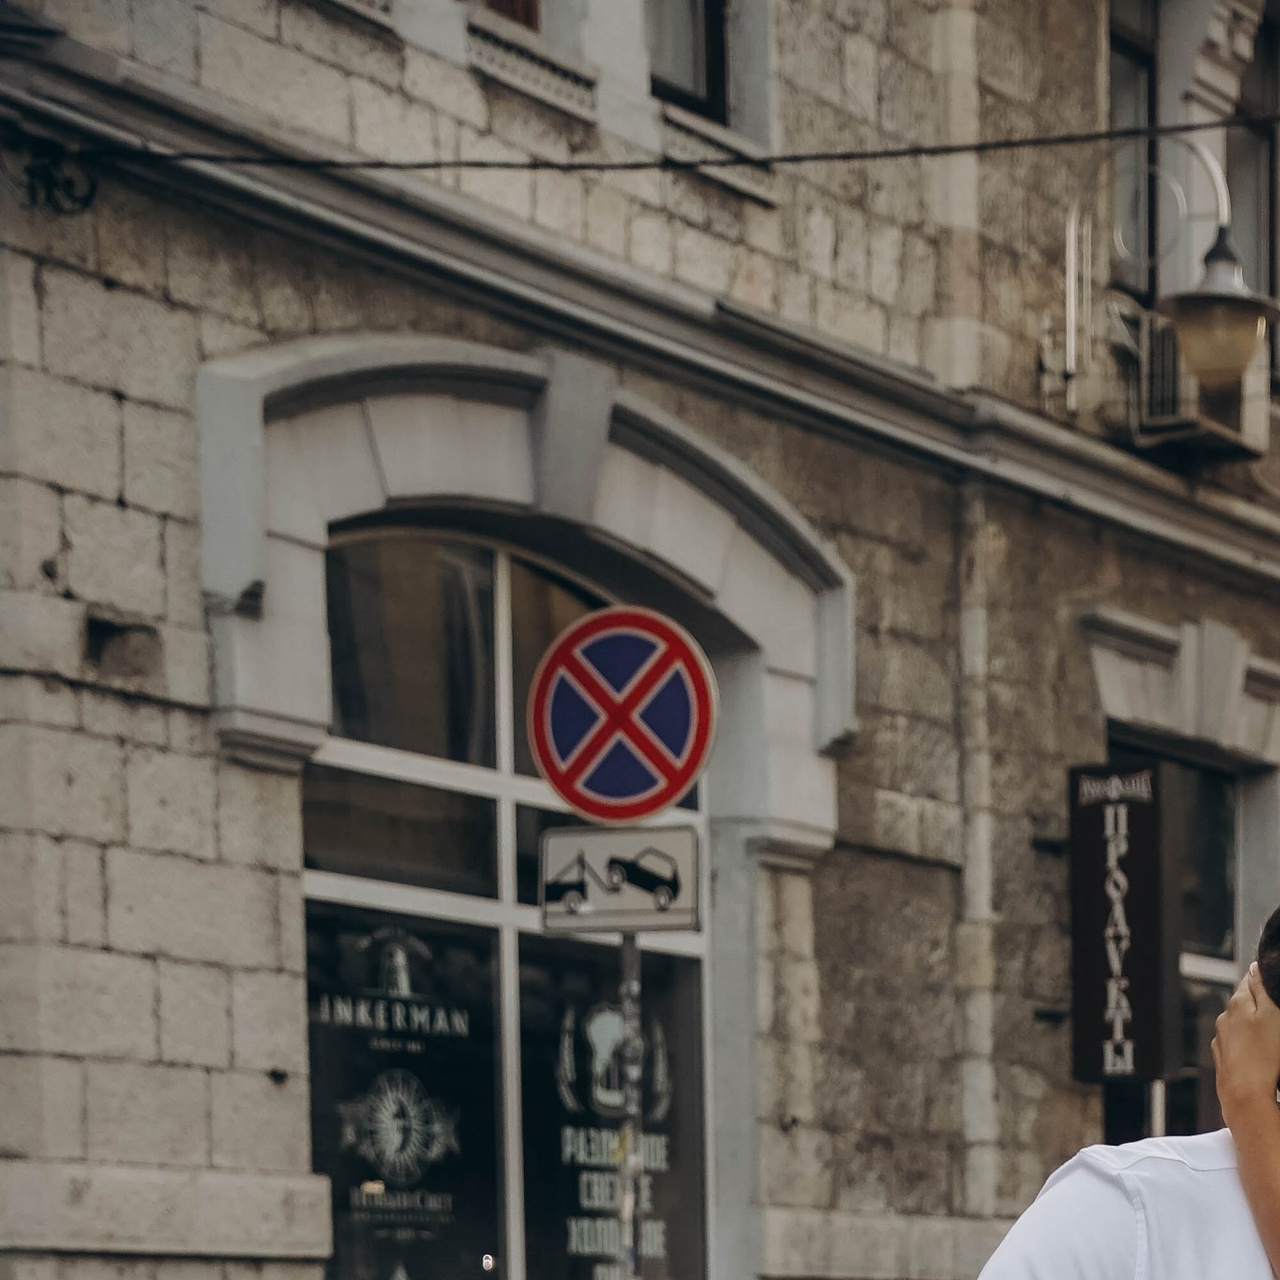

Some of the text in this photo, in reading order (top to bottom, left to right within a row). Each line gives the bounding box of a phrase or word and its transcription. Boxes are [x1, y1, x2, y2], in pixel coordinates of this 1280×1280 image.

[319, 993, 469, 1038] INKERMAN
[578, 1170, 653, 1212] СВЕЕ
[566, 1217, 667, 1259] ХОЛООЕ
